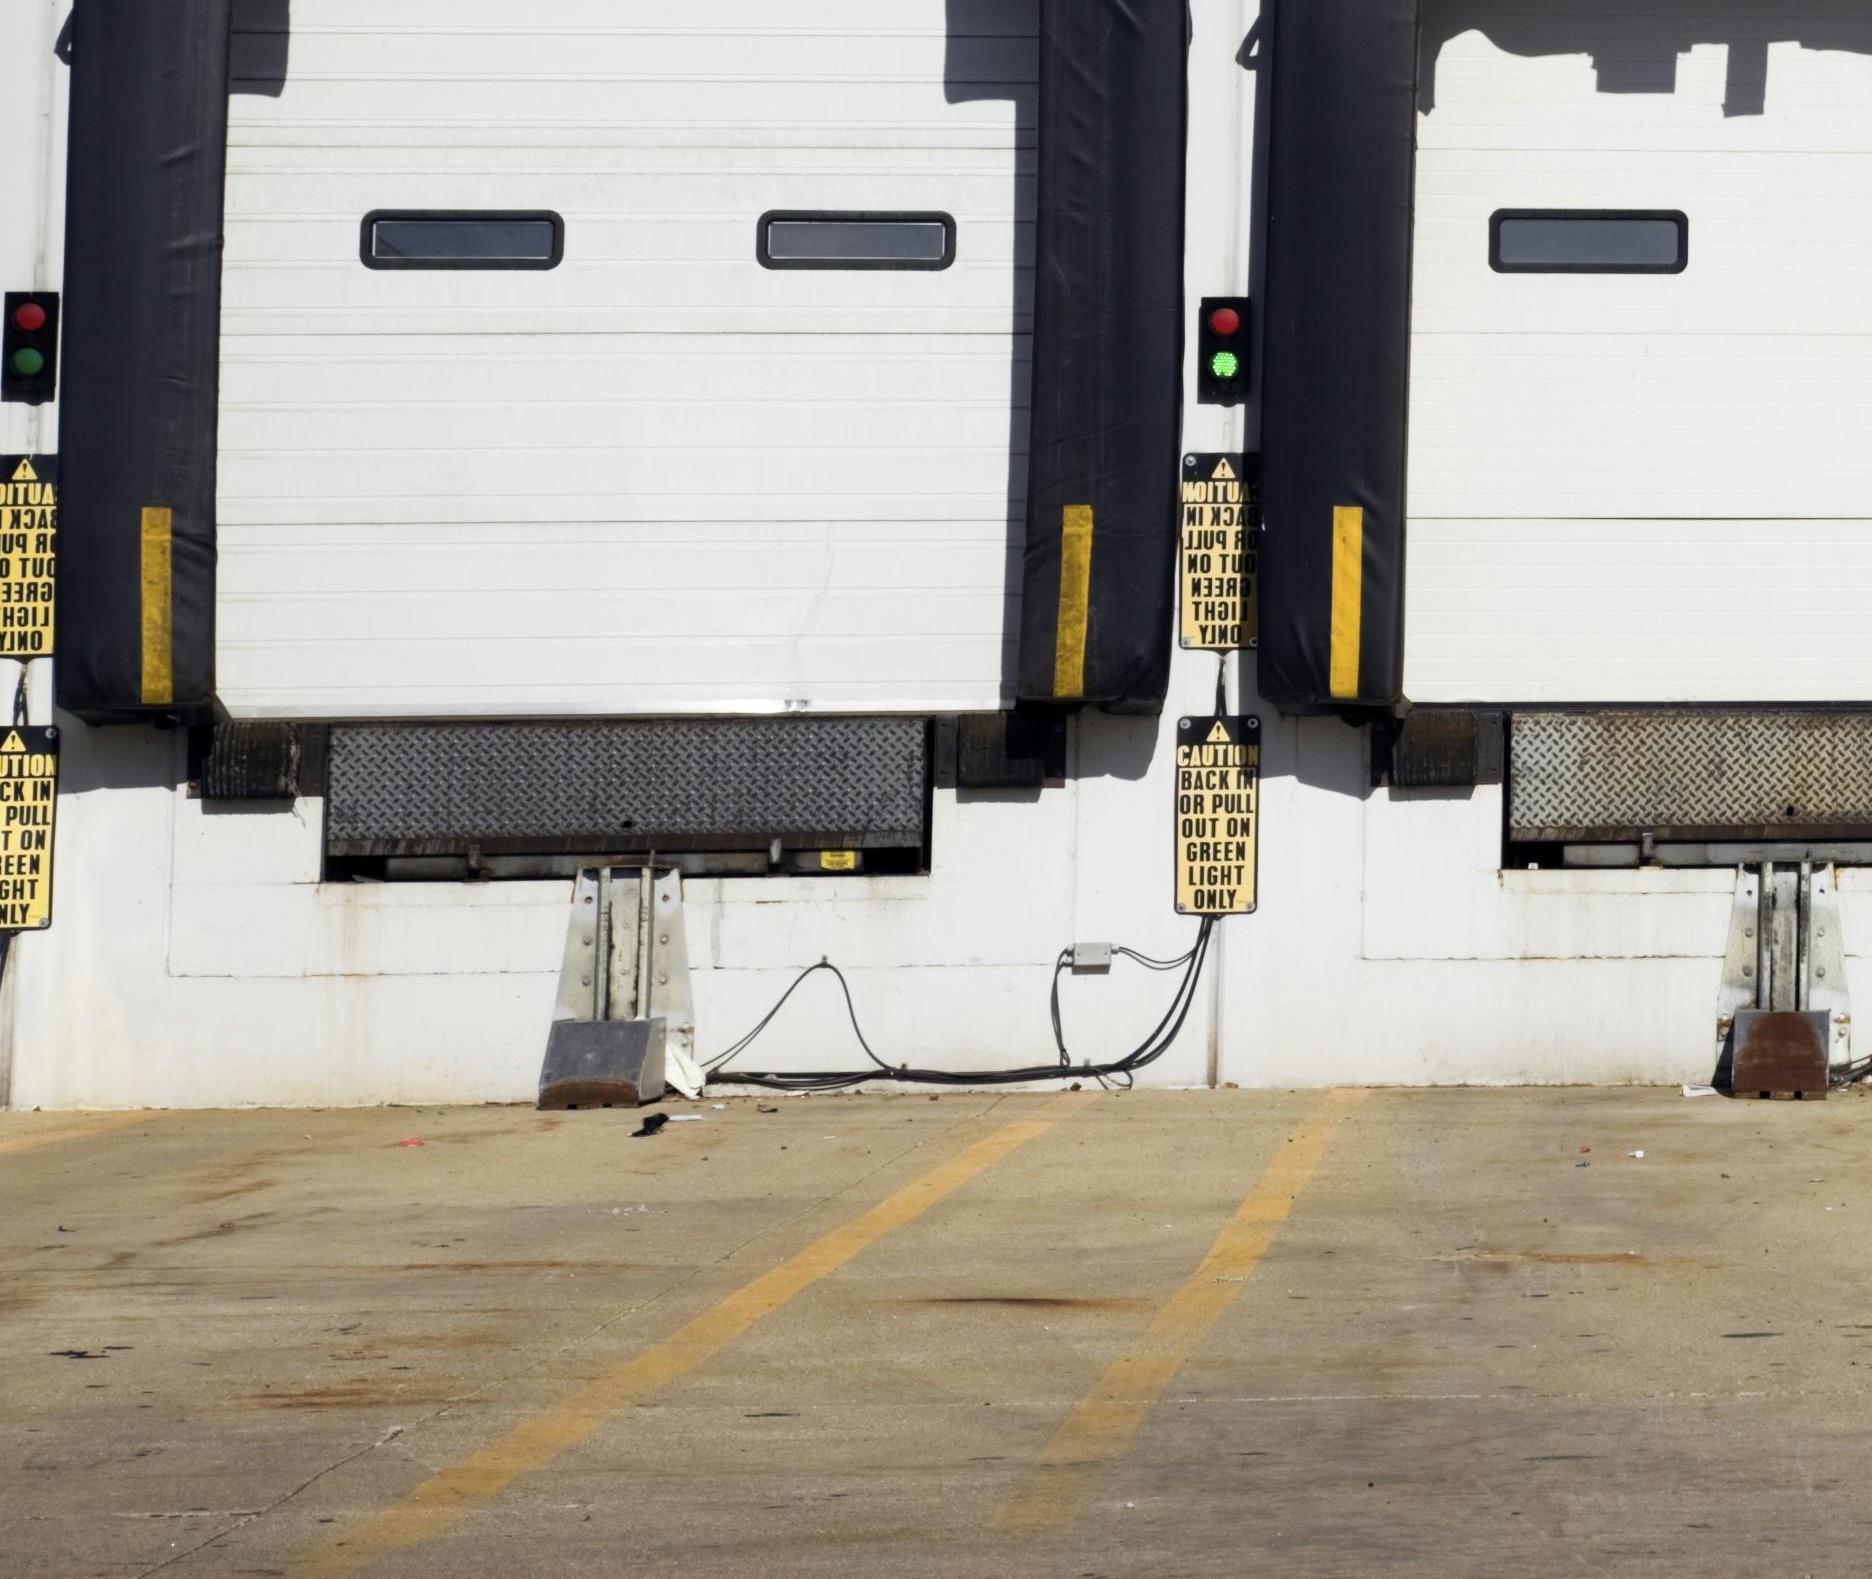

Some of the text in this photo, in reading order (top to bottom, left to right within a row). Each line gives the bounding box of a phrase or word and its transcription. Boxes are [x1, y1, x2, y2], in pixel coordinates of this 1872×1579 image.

[0, 754, 57, 777] UTION
[1177, 745, 1259, 767] CAUTION
[1181, 769, 1253, 790] BACK IN
[0, 781, 51, 801] CK IN
[1179, 793, 1254, 814] OR PULL
[6, 805, 50, 826] PULL
[1181, 817, 1250, 838] OUT ON
[20, 830, 46, 851] ON
[1186, 841, 1246, 862] GREEN
[0, 854, 40, 875] EEN
[1188, 865, 1244, 886] LIGHT
[0, 879, 39, 900] GHT
[1194, 889, 1237, 910] ONLY
[0, 904, 30, 924] NLY
